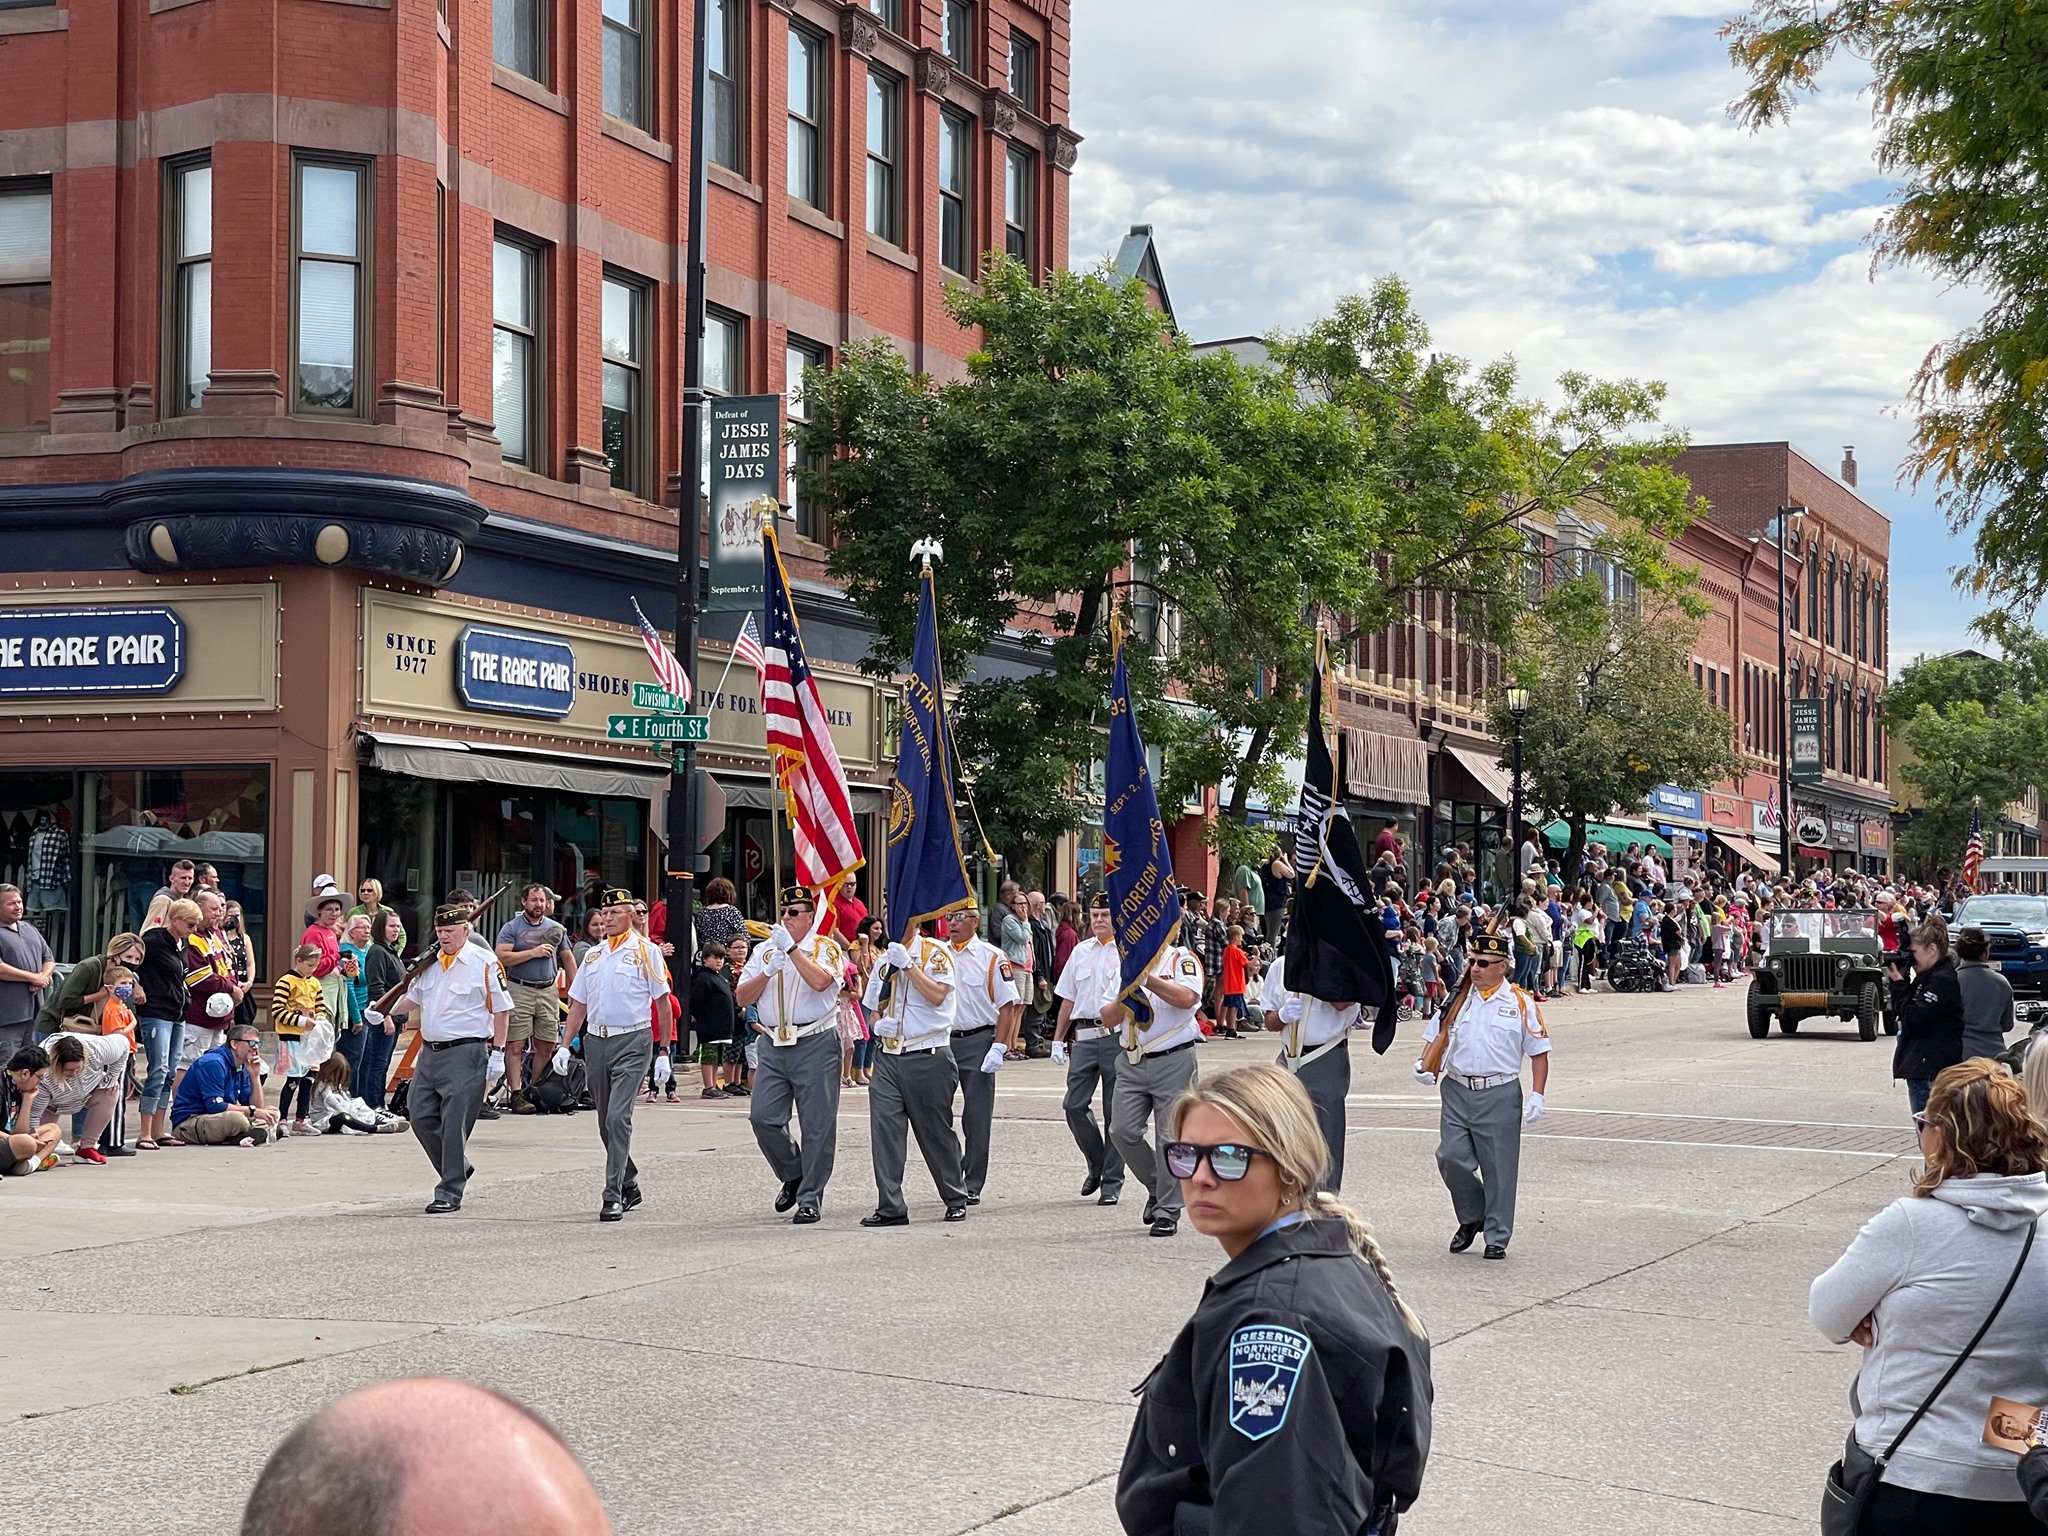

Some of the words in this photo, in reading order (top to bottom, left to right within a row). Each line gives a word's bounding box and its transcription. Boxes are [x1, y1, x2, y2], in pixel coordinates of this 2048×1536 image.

[715, 411, 739, 419] Defeat
[740, 410, 749, 418] of
[721, 423, 769, 439] JESSE
[719, 443, 770, 459] JAMES
[724, 463, 765, 479] DAYS
[711, 585, 750, 595] September
[751, 585, 758, 593] 7,
[0, 638, 24, 667] HE
[30, 636, 100, 667] RARE
[107, 634, 166, 665] PAIR
[386, 632, 437, 656] SINCE
[395, 654, 428, 675] 1977
[469, 651, 499, 682] THE
[502, 656, 538, 688] RARE
[540, 661, 571, 692] PAIR
[578, 672, 629, 696] SHOES
[729, 694, 758, 714] FOR
[825, 708, 853, 727] MEN
[639, 686, 670, 709] Division
[632, 718, 639, 737] E
[644, 718, 684, 738] Fourth
[688, 719, 702, 738] St
[1120, 861, 1158, 919] FOREIGN
[1124, 904, 1161, 945] UNITED
[1240, 1331, 1302, 1348] RESERVE
[1235, 1344, 1301, 1360] NORTHFIELD
[1247, 1351, 1285, 1363] POLICE
